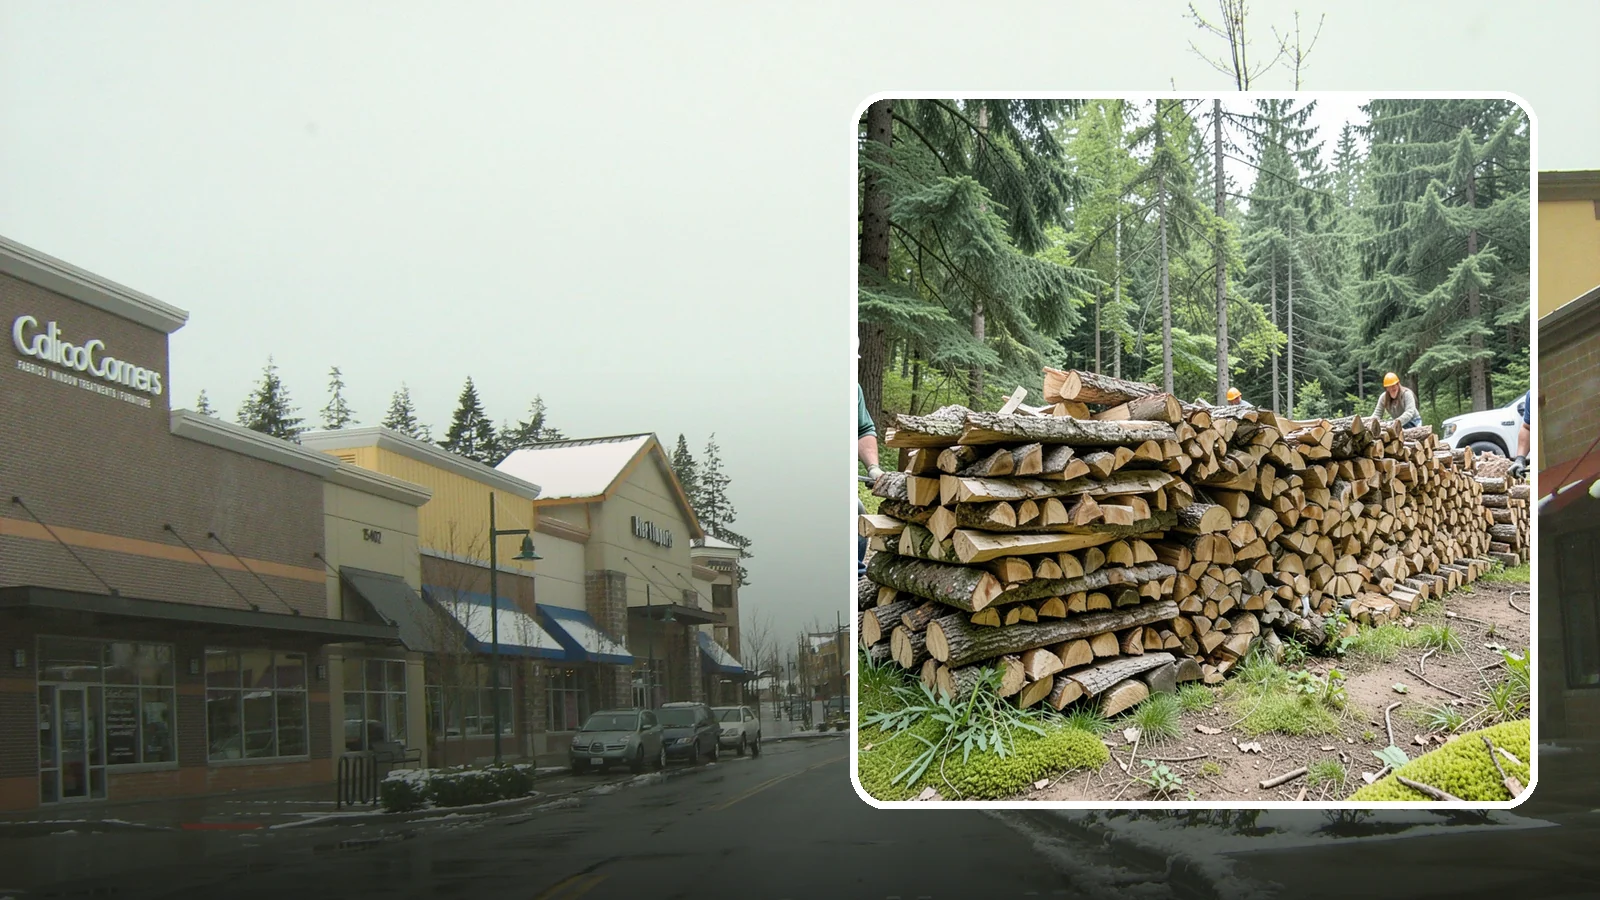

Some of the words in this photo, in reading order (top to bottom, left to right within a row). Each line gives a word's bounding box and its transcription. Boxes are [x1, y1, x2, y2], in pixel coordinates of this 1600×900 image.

[17, 360, 47, 378] FABRICS
[51, 370, 78, 387] WINDOW
[78, 378, 117, 399] TREATMENTS
